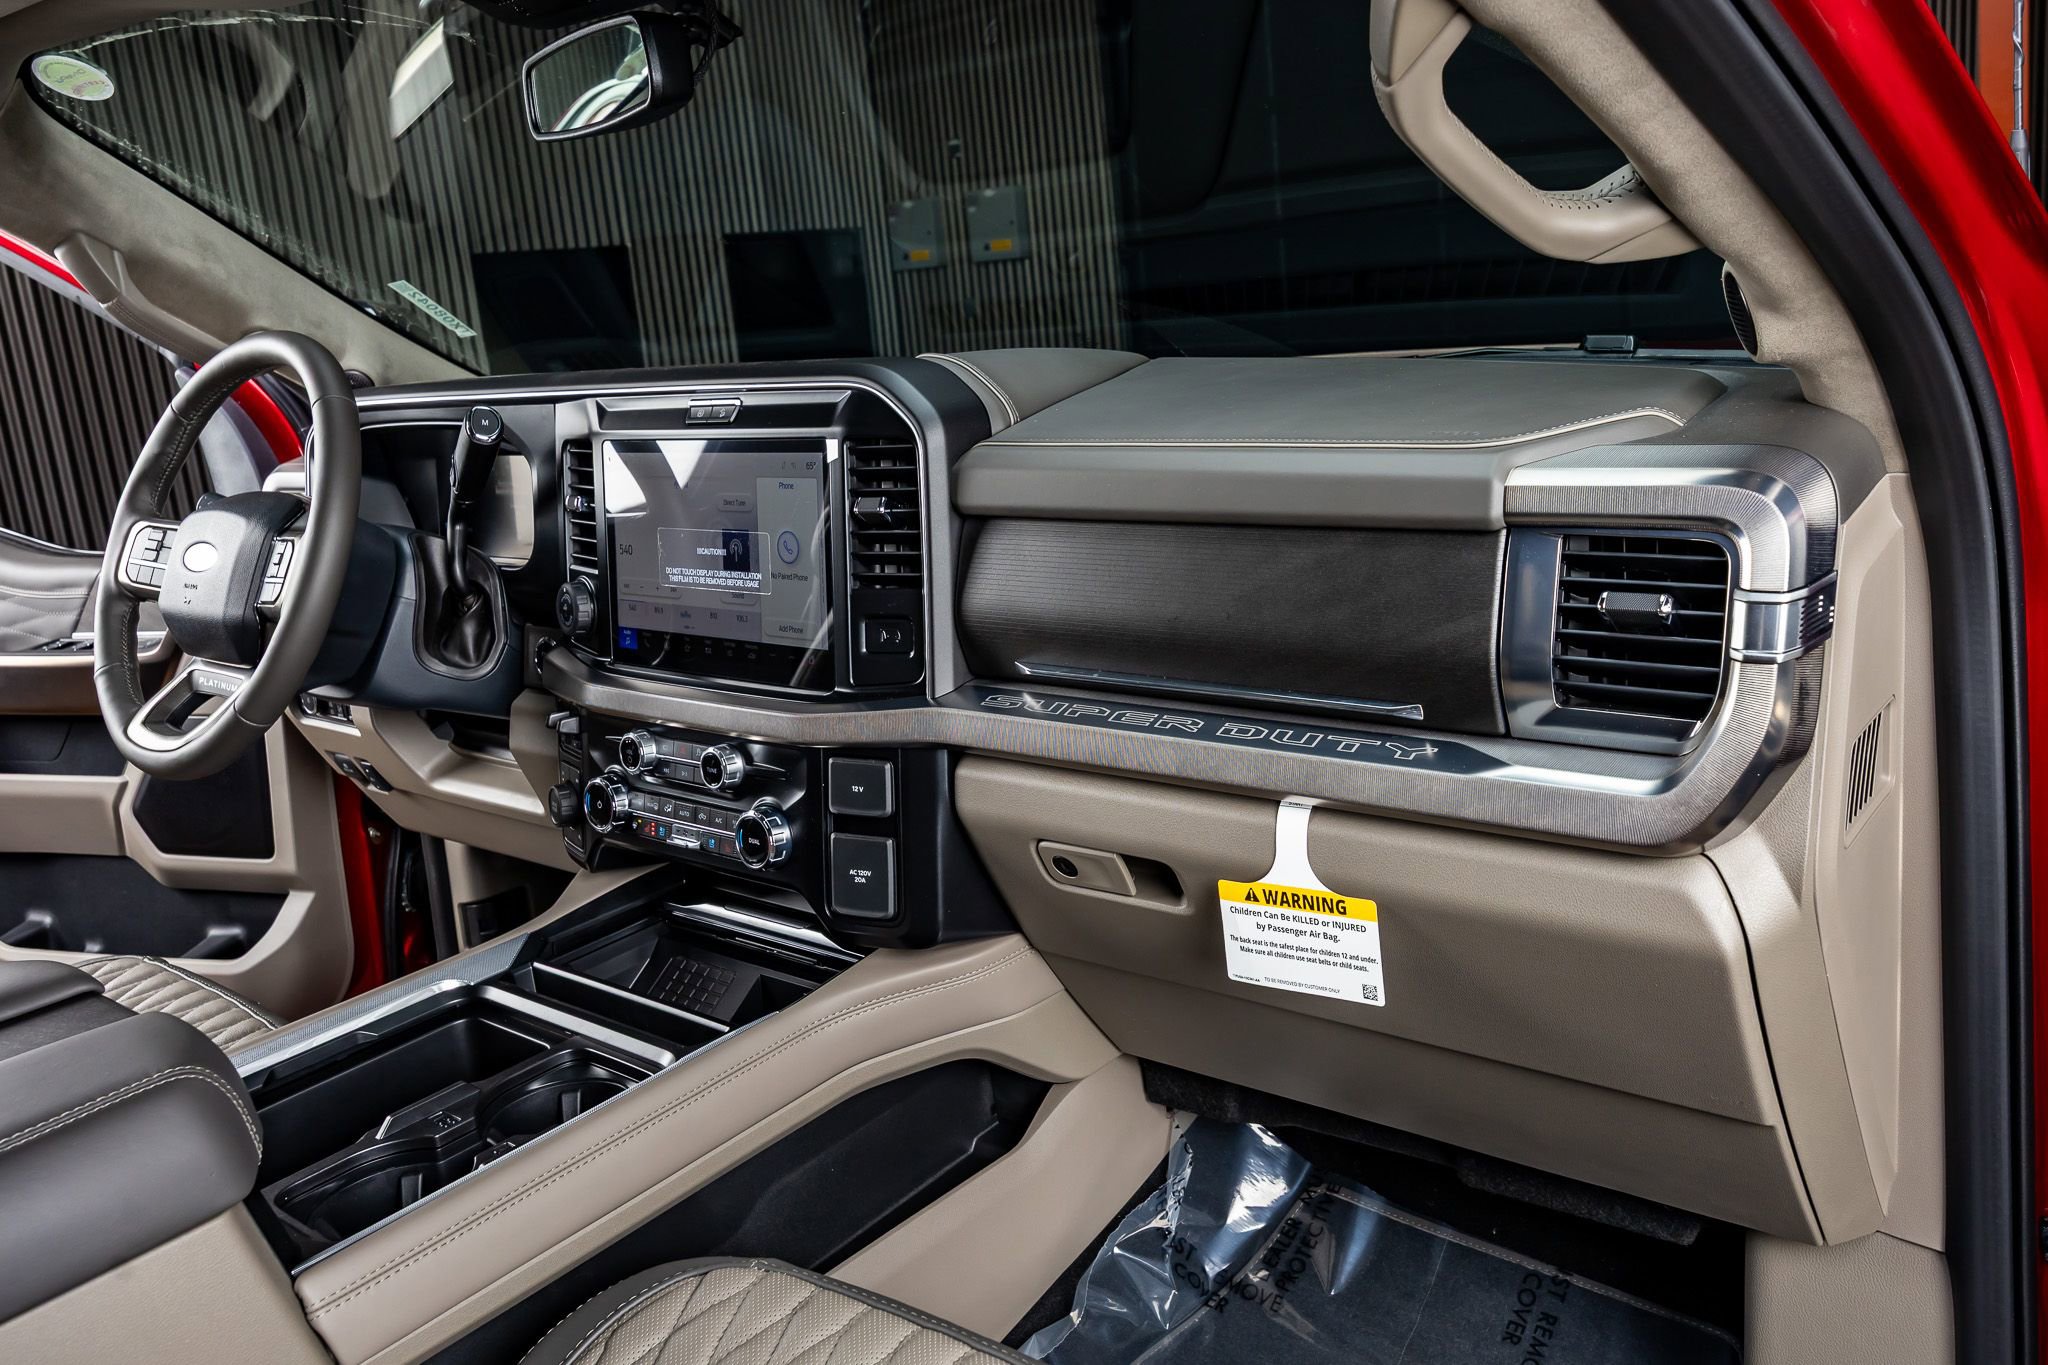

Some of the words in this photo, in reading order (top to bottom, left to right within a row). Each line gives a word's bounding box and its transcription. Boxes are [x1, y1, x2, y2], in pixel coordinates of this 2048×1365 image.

[778, 482, 794, 490] Phone
[620, 544, 633, 556] 540
[666, 566, 672, 574] DO
[672, 567, 681, 575] NOT
[681, 568, 697, 576] TOUCH
[697, 569, 714, 577] DISPLAY
[714, 570, 731, 578] DURING
[731, 571, 762, 580] INSTALLATION
[669, 574, 679, 582] THIS
[678, 575, 689, 583] FILM
[705, 578, 726, 586] REMOVED
[726, 579, 745, 587] BEFORE
[744, 580, 760, 588] USAGE
[778, 573, 793, 581] Paired
[793, 573, 808, 582] Phone
[779, 625, 788, 633] Add
[789, 625, 804, 634] Phone
[199, 676, 238, 692] PLATINUM
[981, 694, 1204, 732] SUPER
[1215, 722, 1439, 761] DUTY
[679, 809, 690, 817] AUTO
[1262, 889, 1347, 916] WARNING
[1230, 906, 1262, 918] Children
[1263, 910, 1279, 920] Can
[1280, 913, 1291, 922] Be
[1292, 915, 1320, 926] KILLED
[1332, 920, 1367, 933] INJURED
[1256, 922, 1266, 932] by
[1268, 924, 1308, 938] Passenger
[1309, 930, 1321, 939] Air
[1322, 932, 1340, 943] Bag.
[1230, 934, 1239, 942] The
[1240, 936, 1251, 944] back
[1279, 943, 1295, 951] safest
[1295, 945, 1309, 953] place
[1309, 946, 1318, 954] for
[1319, 949, 1340, 958] children
[1341, 952, 1348, 960] 12
[1360, 956, 1379, 965] under.
[1240, 945, 1254, 954] Make
[1274, 951, 1295, 960] children
[1318, 958, 1331, 966] belts
[1339, 962, 1352, 970] child
[1353, 964, 1369, 972] seats.
[1304, 983, 1328, 991] CUSTOMER
[1275, 1183, 1342, 1293] PROTECTIVE
[1255, 1217, 1303, 1283] DEALER
[1174, 1262, 1230, 1314] COVER
[1501, 1273, 1543, 1346] COVER
